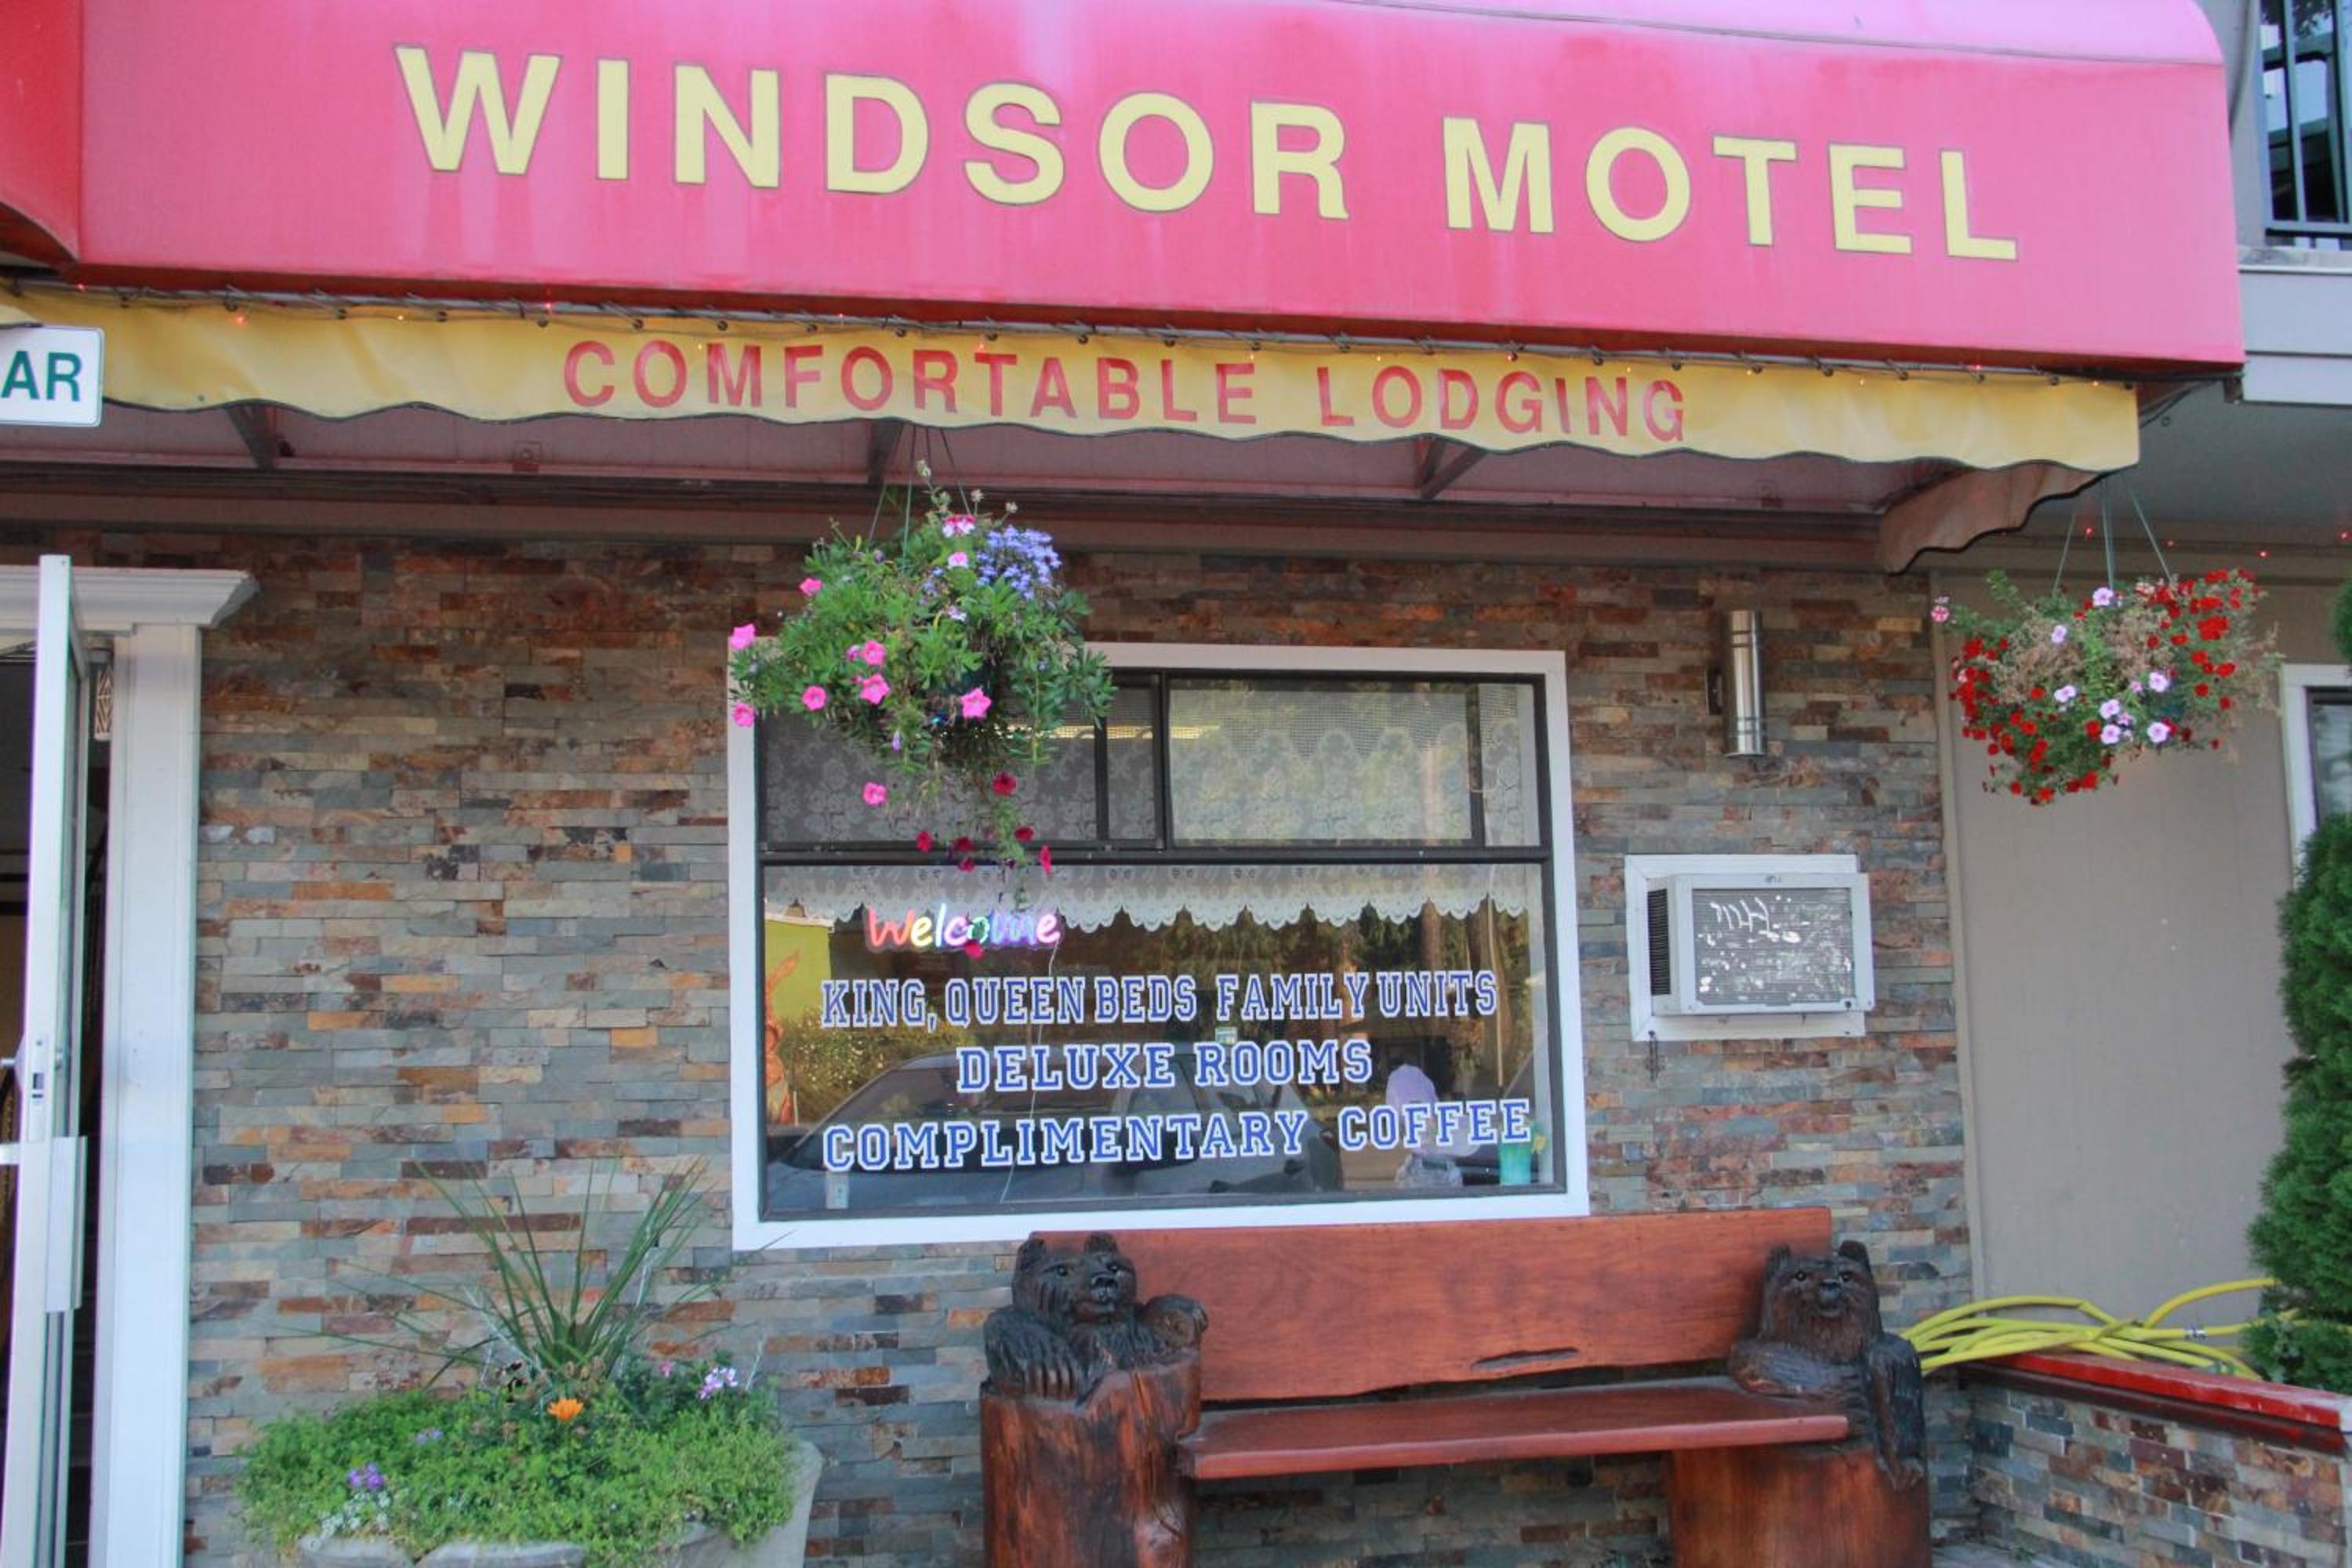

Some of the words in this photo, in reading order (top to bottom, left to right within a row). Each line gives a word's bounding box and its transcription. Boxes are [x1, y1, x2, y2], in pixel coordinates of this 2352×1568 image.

[394, 45, 1349, 220] WINDSOR
[1443, 116, 2018, 261] MOTEL
[564, 339, 1256, 423] COMFORTABLE
[1317, 367, 1684, 441] LODGING
[821, 978, 938, 1033] KING,
[945, 977, 1085, 1028] QUEEN
[1094, 975, 1197, 1022] BEDS
[1216, 973, 1370, 1021] FAMILY
[1376, 971, 1498, 1018] UNITS
[956, 1044, 1175, 1093] DELUXE
[1194, 1040, 1372, 1087] ROOMS
[822, 1110, 1308, 1172] COMPLIMENTARY
[1337, 1099, 1531, 1151] COFFEE
